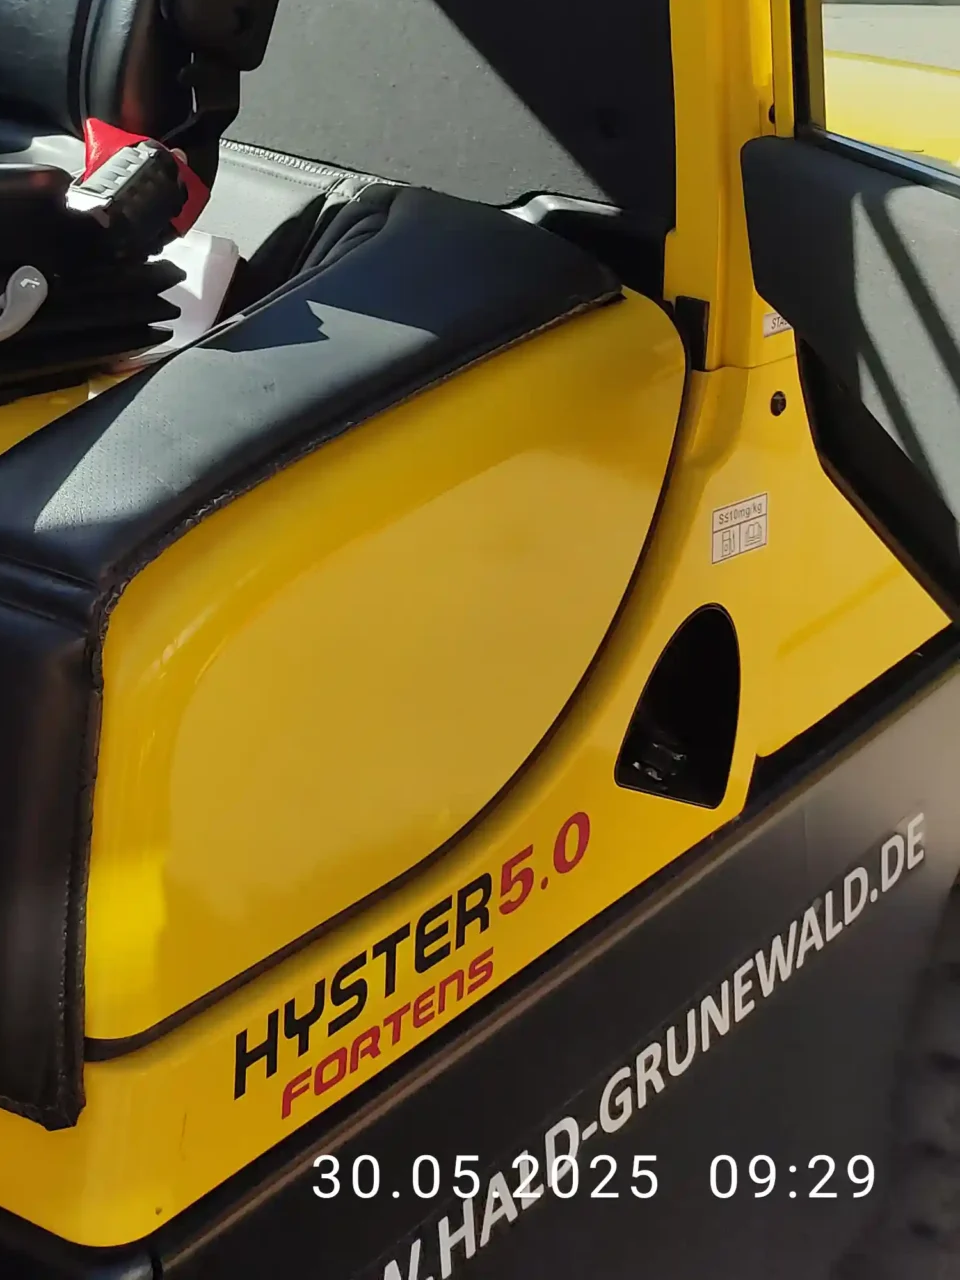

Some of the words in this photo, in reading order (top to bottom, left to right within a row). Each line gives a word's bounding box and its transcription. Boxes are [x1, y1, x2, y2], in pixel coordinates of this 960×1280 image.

[233, 872, 492, 1101] HYSTER
[499, 812, 591, 915] 5.0
[281, 946, 496, 1120] FORTENS
